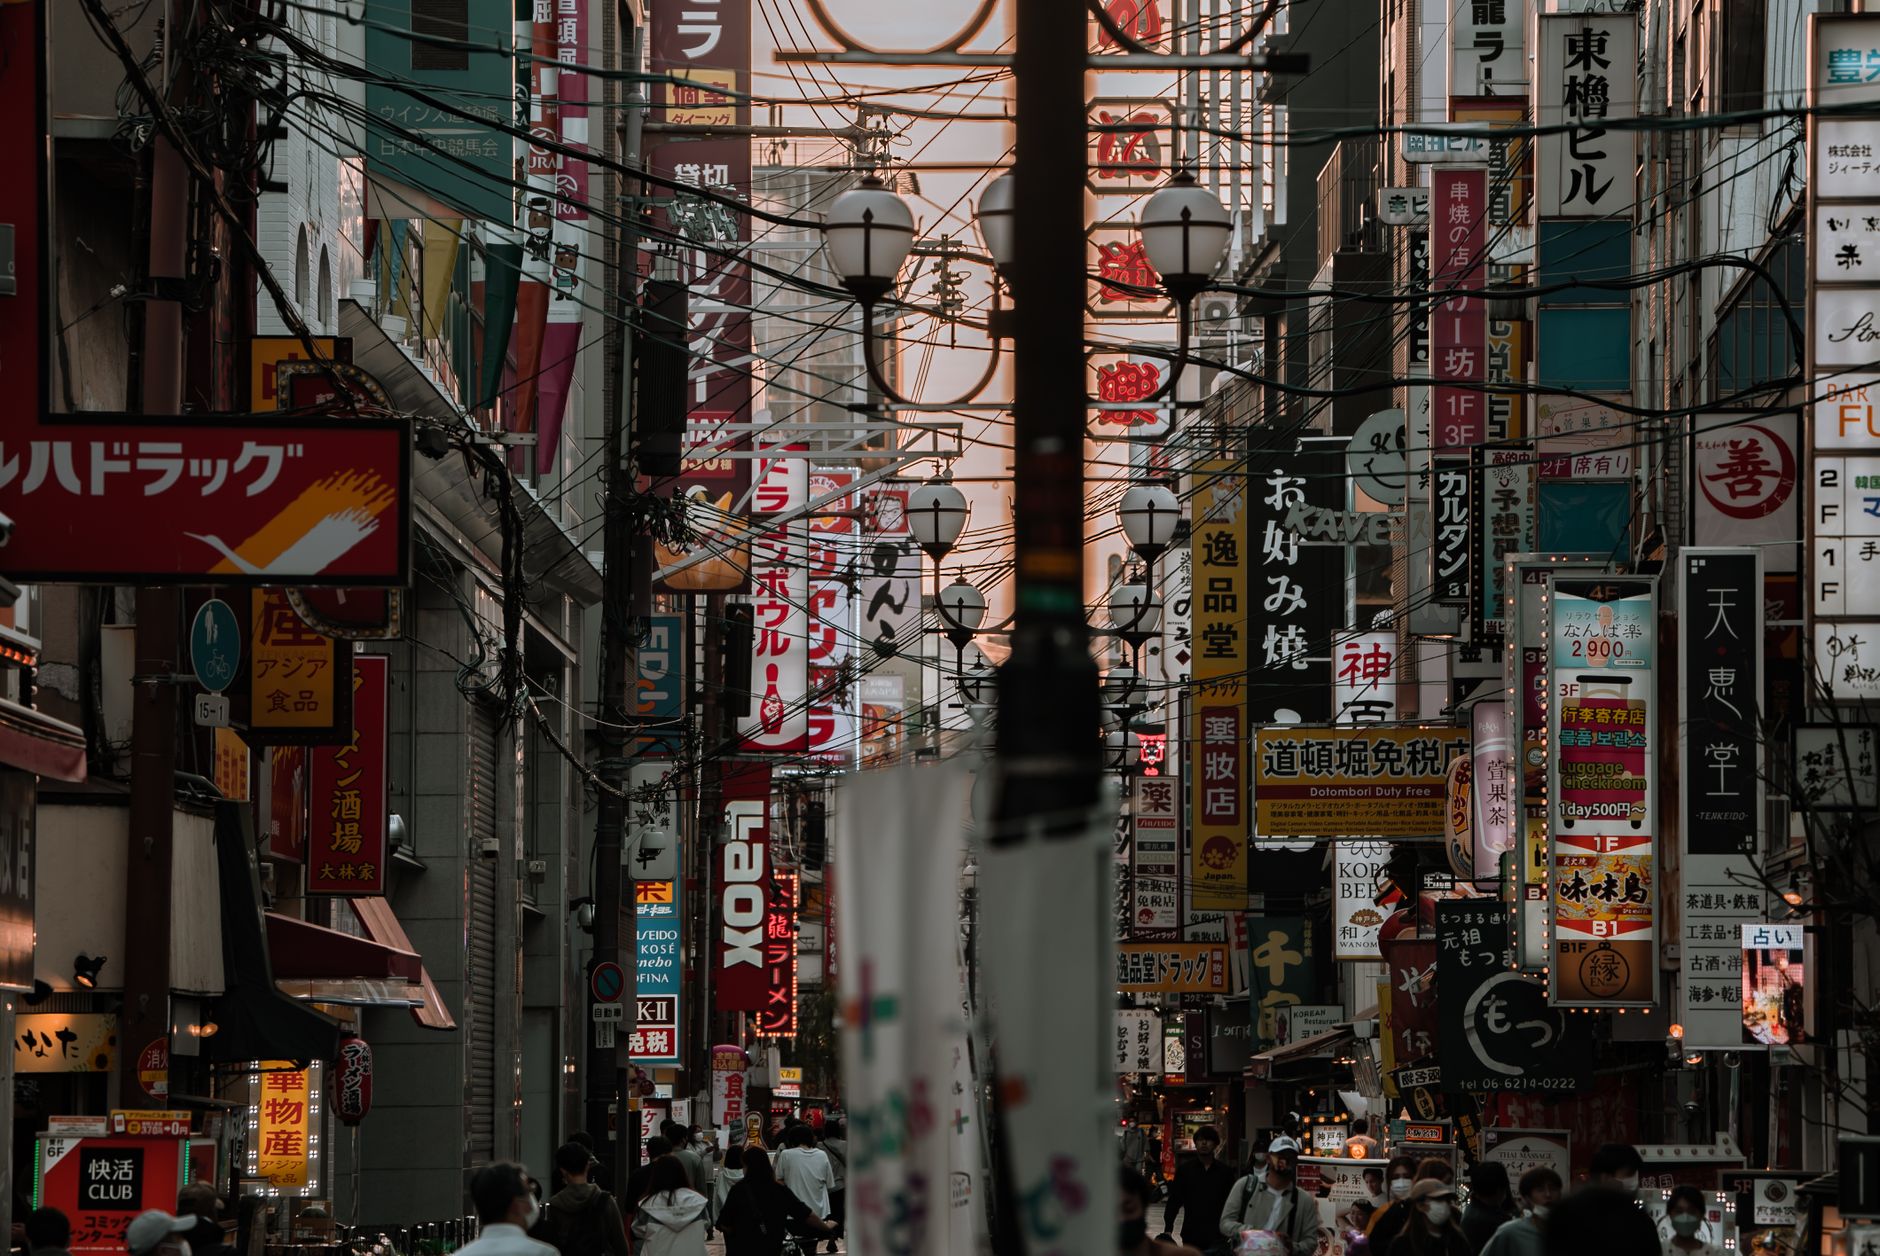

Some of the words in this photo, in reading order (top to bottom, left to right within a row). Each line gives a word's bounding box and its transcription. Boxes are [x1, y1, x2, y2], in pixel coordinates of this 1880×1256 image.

[677, 0, 722, 59] ラ
[1828, 145, 1872, 157] 株式会社
[1828, 163, 1880, 174] ジィーティ
[558, 206, 578, 214] RA
[1388, 196, 1428, 216] 幸ビ
[1449, 181, 1471, 266] 串焼の店
[1827, 384, 1868, 402] BAR
[1447, 396, 1475, 416] 1F
[1445, 424, 1475, 446] 3F
[1574, 455, 1629, 475] 席有り
[1705, 438, 1781, 500] 善
[1438, 472, 1469, 577] カルダン
[1262, 469, 1308, 670] お好み焼
[1202, 530, 1238, 658] 逸品堂
[1589, 585, 1619, 600] 4F
[1564, 623, 1642, 639] なんば楽
[256, 659, 328, 679] アジア
[1559, 684, 1579, 697] 3F
[1703, 588, 1743, 797] 天恵堂
[267, 689, 319, 714] 食品
[198, 702, 223, 721] 15-1
[1562, 705, 1646, 726] 行李寄存店
[1560, 729, 1593, 747] 물품
[1597, 729, 1647, 747] 보관소
[331, 667, 365, 855] メン酒場
[1558, 758, 1624, 775] Luggage
[1562, 774, 1647, 791] Checkroom
[1141, 783, 1171, 812] 薬
[1376, 786, 1401, 798] Duty
[1406, 786, 1431, 796] Free
[1594, 837, 1619, 851] 1F
[320, 863, 376, 881] 大林家
[1340, 882, 1379, 899] BEE
[1340, 926, 1377, 940] 和ノ
[1592, 920, 1618, 935] B1
[1340, 941, 1378, 949] WANOM
[1441, 929, 1482, 951] 元祖
[1753, 928, 1792, 946] 占い
[641, 943, 675, 955] KOSÉ
[1560, 942, 1588, 953] B1F
[637, 957, 672, 968] nebo
[1689, 955, 1742, 971] 古酒・洋
[637, 1001, 668, 1021] K-II
[1293, 1010, 1326, 1019] KOREAN
[629, 1032, 668, 1054] 免税
[1138, 1019, 1150, 1070] お好み焼
[344, 1045, 363, 1114] ラーメン酒場
[1460, 1078, 1477, 1090] tel
[47, 1146, 65, 1158] 6F
[88, 1158, 135, 1181] 快活
[261, 1160, 304, 1170] アジア
[268, 1173, 298, 1184] 食品
[87, 1184, 134, 1200] CLUB
[69, 1230, 130, 1243] インターネ
